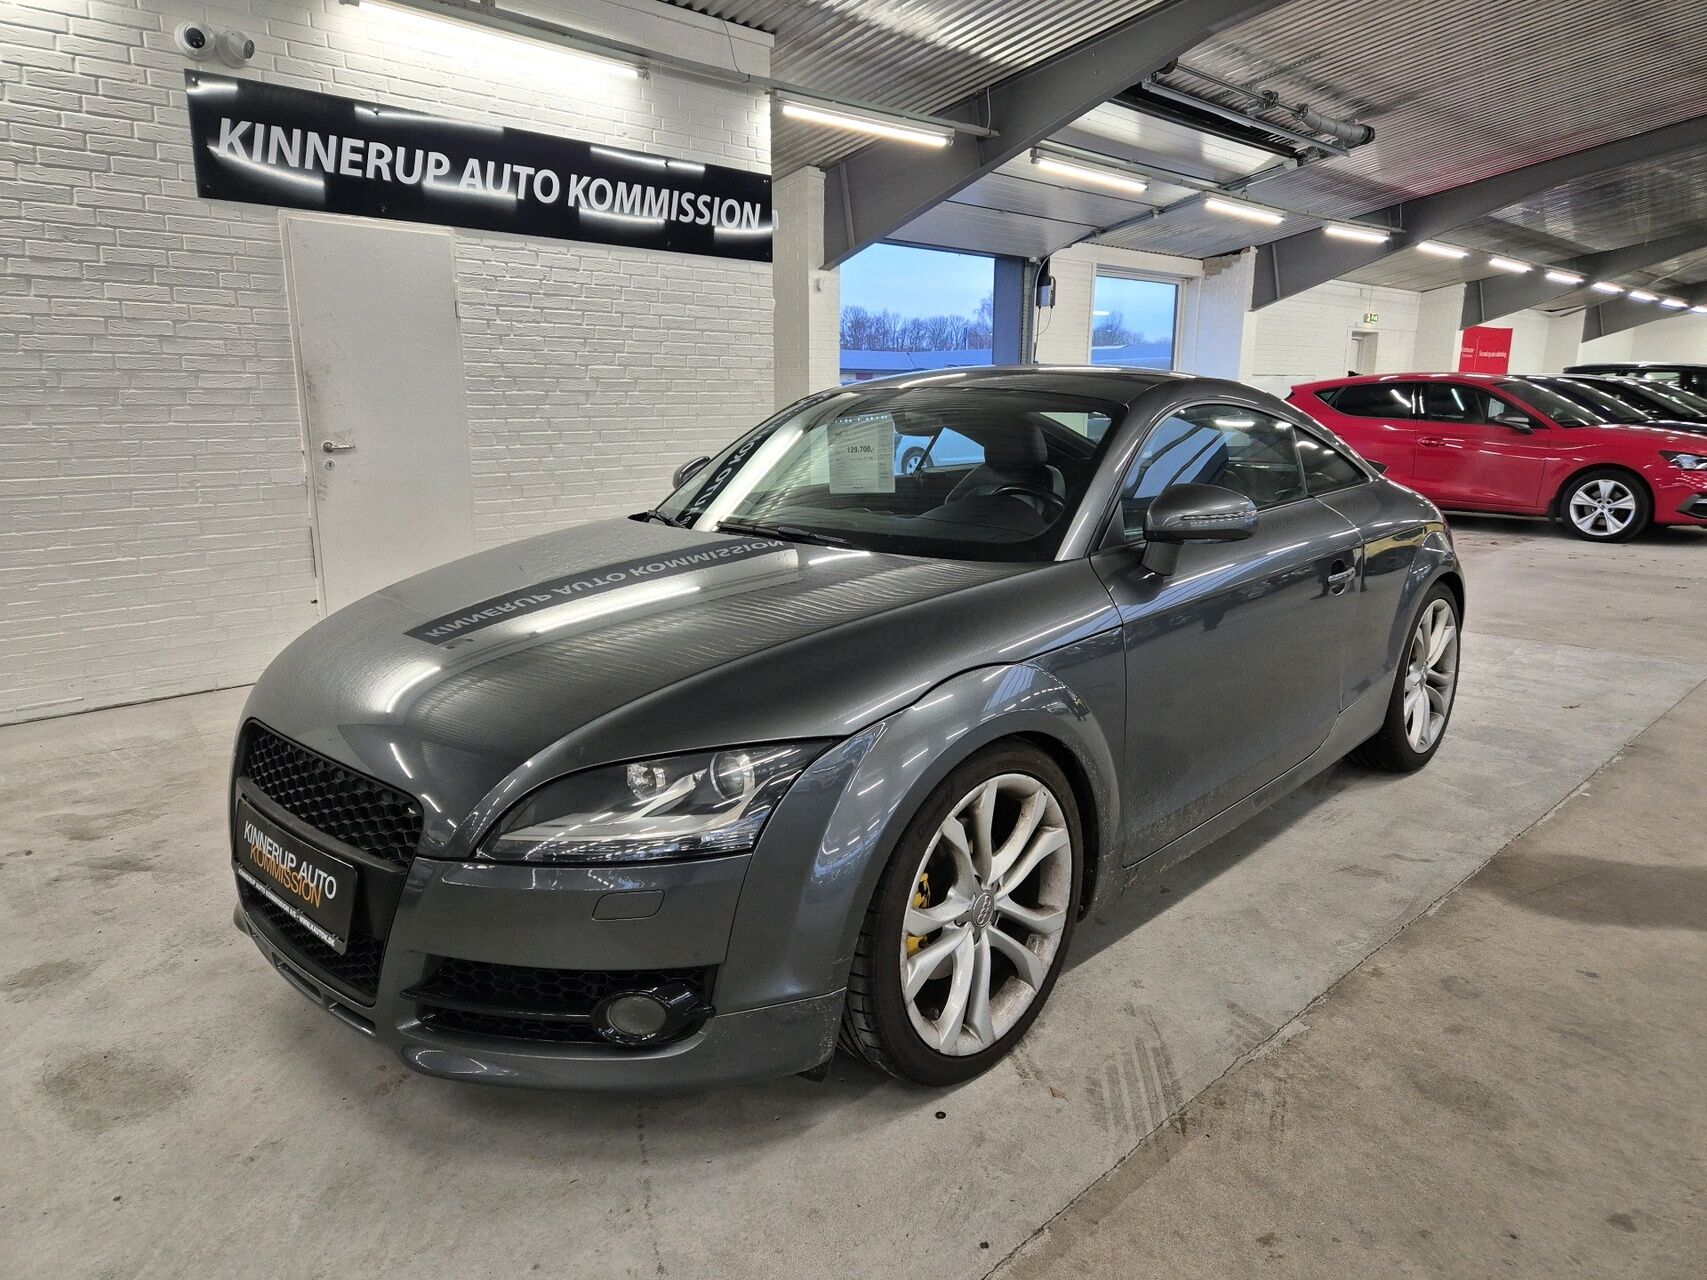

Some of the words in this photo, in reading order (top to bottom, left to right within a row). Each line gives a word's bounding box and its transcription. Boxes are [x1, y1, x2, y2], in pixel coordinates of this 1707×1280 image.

[217, 117, 451, 185] KINNERUP
[460, 157, 560, 204] AUTO
[568, 177, 761, 230] KOMMISSION
[244, 820, 297, 869] KINNERUP
[299, 861, 337, 900] AUTO
[250, 845, 322, 908] KOMMISSION
